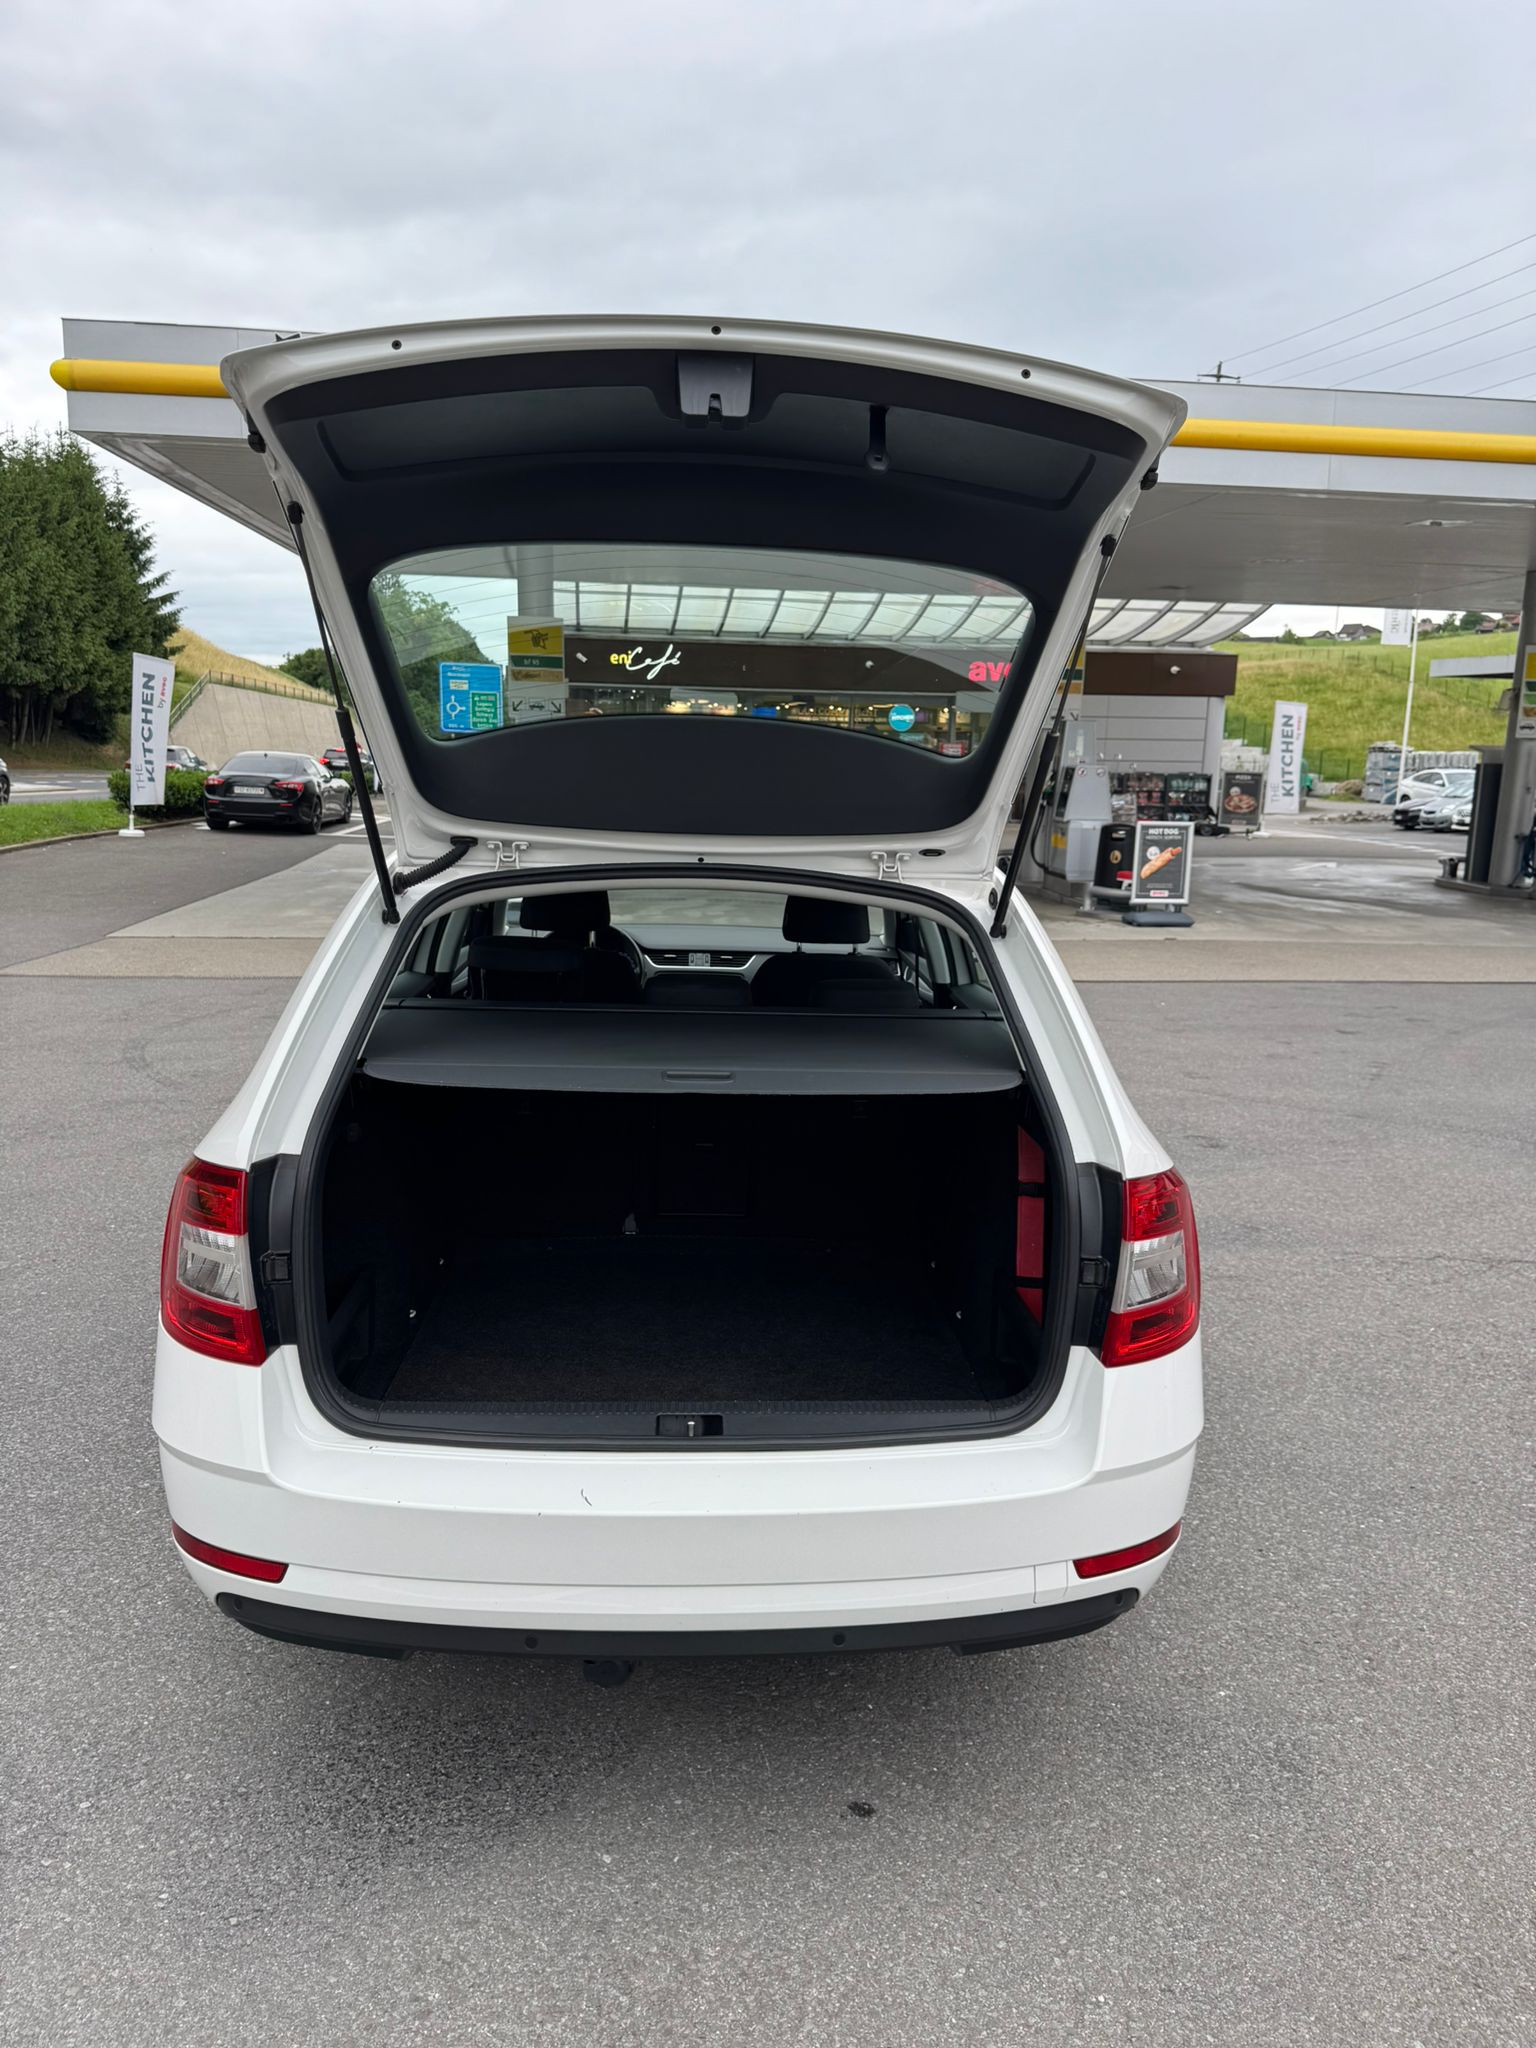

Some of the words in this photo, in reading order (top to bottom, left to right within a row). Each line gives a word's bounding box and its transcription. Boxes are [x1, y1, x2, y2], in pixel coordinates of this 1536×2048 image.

[610, 650, 632, 665] eni
[157, 697, 167, 709] by
[141, 672, 156, 783] KITCHEN
[1281, 714, 1295, 797] KITCHEN
[136, 764, 146, 792] THE
[1270, 782, 1280, 804] THE
